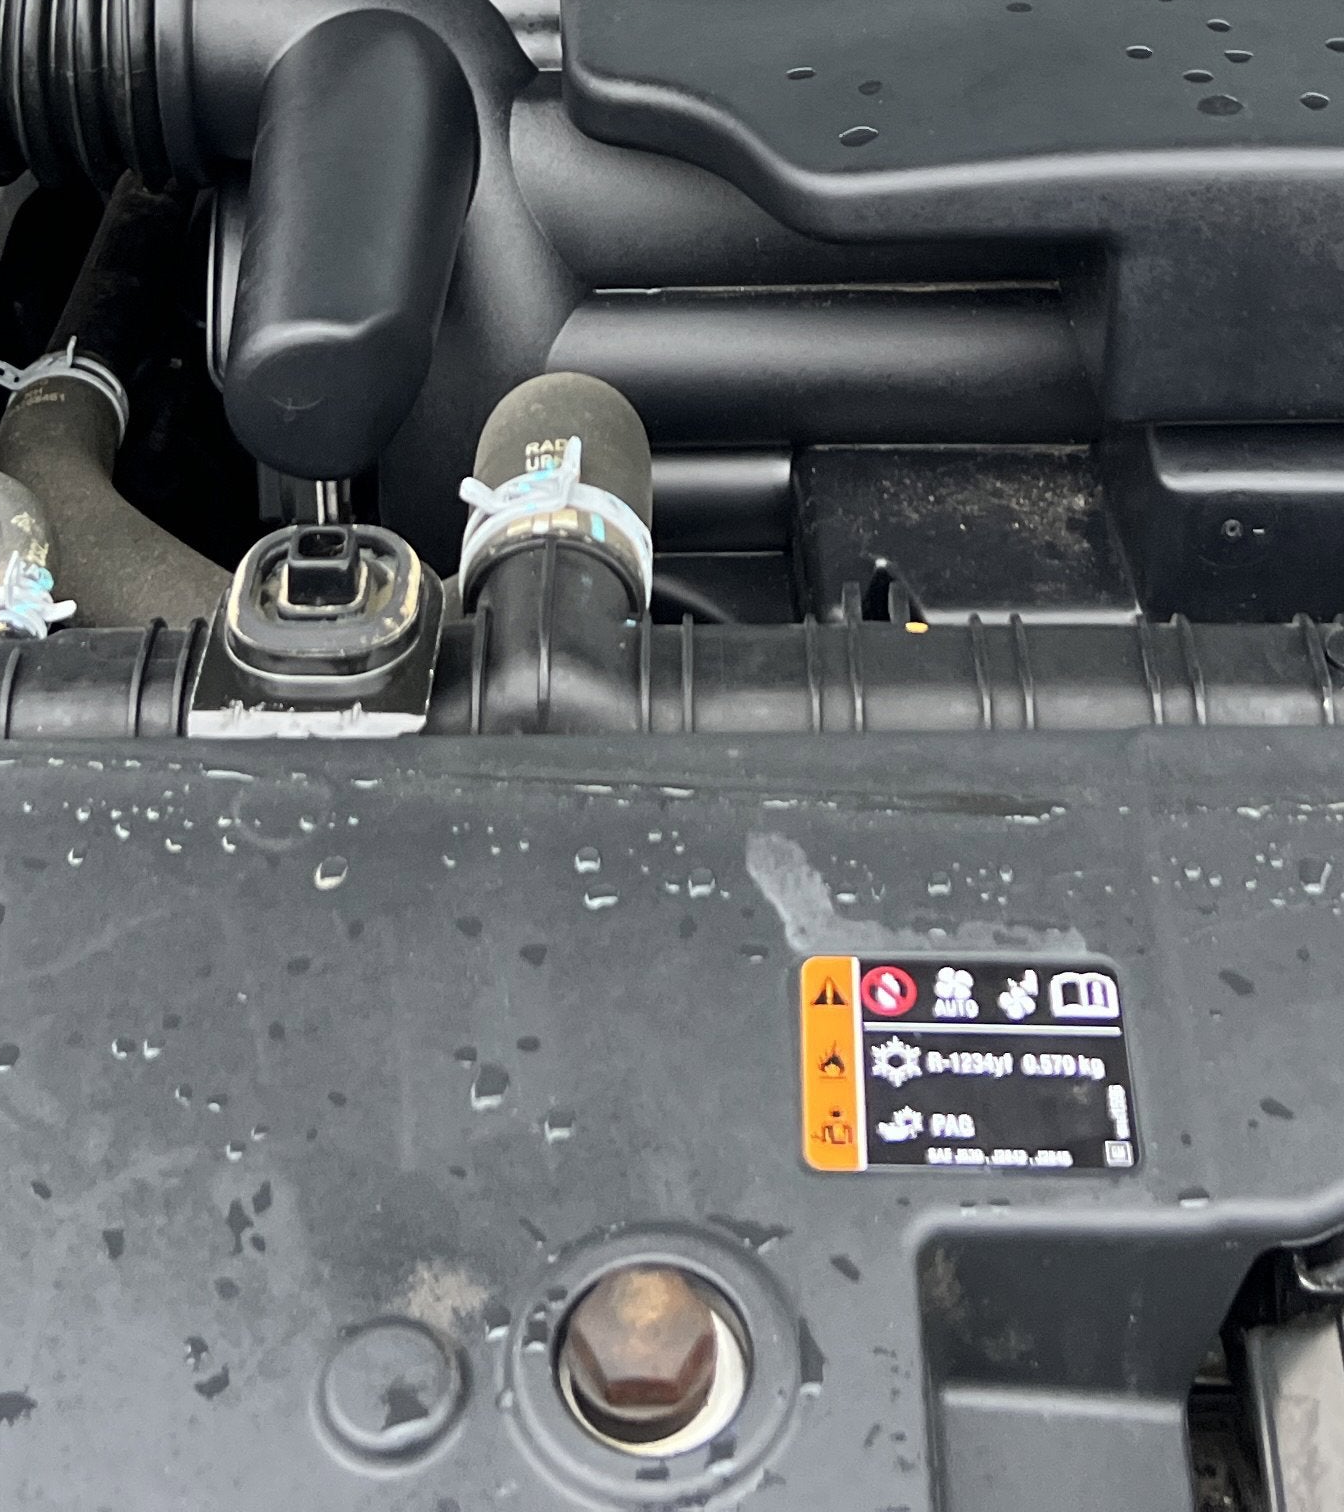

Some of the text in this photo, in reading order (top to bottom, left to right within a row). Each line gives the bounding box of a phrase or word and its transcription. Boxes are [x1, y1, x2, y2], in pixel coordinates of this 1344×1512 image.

[933, 997, 979, 1018] AUTO
[925, 1051, 1106, 1080] R-1234yf 0.570 kg
[930, 1112, 976, 1138] PAG
